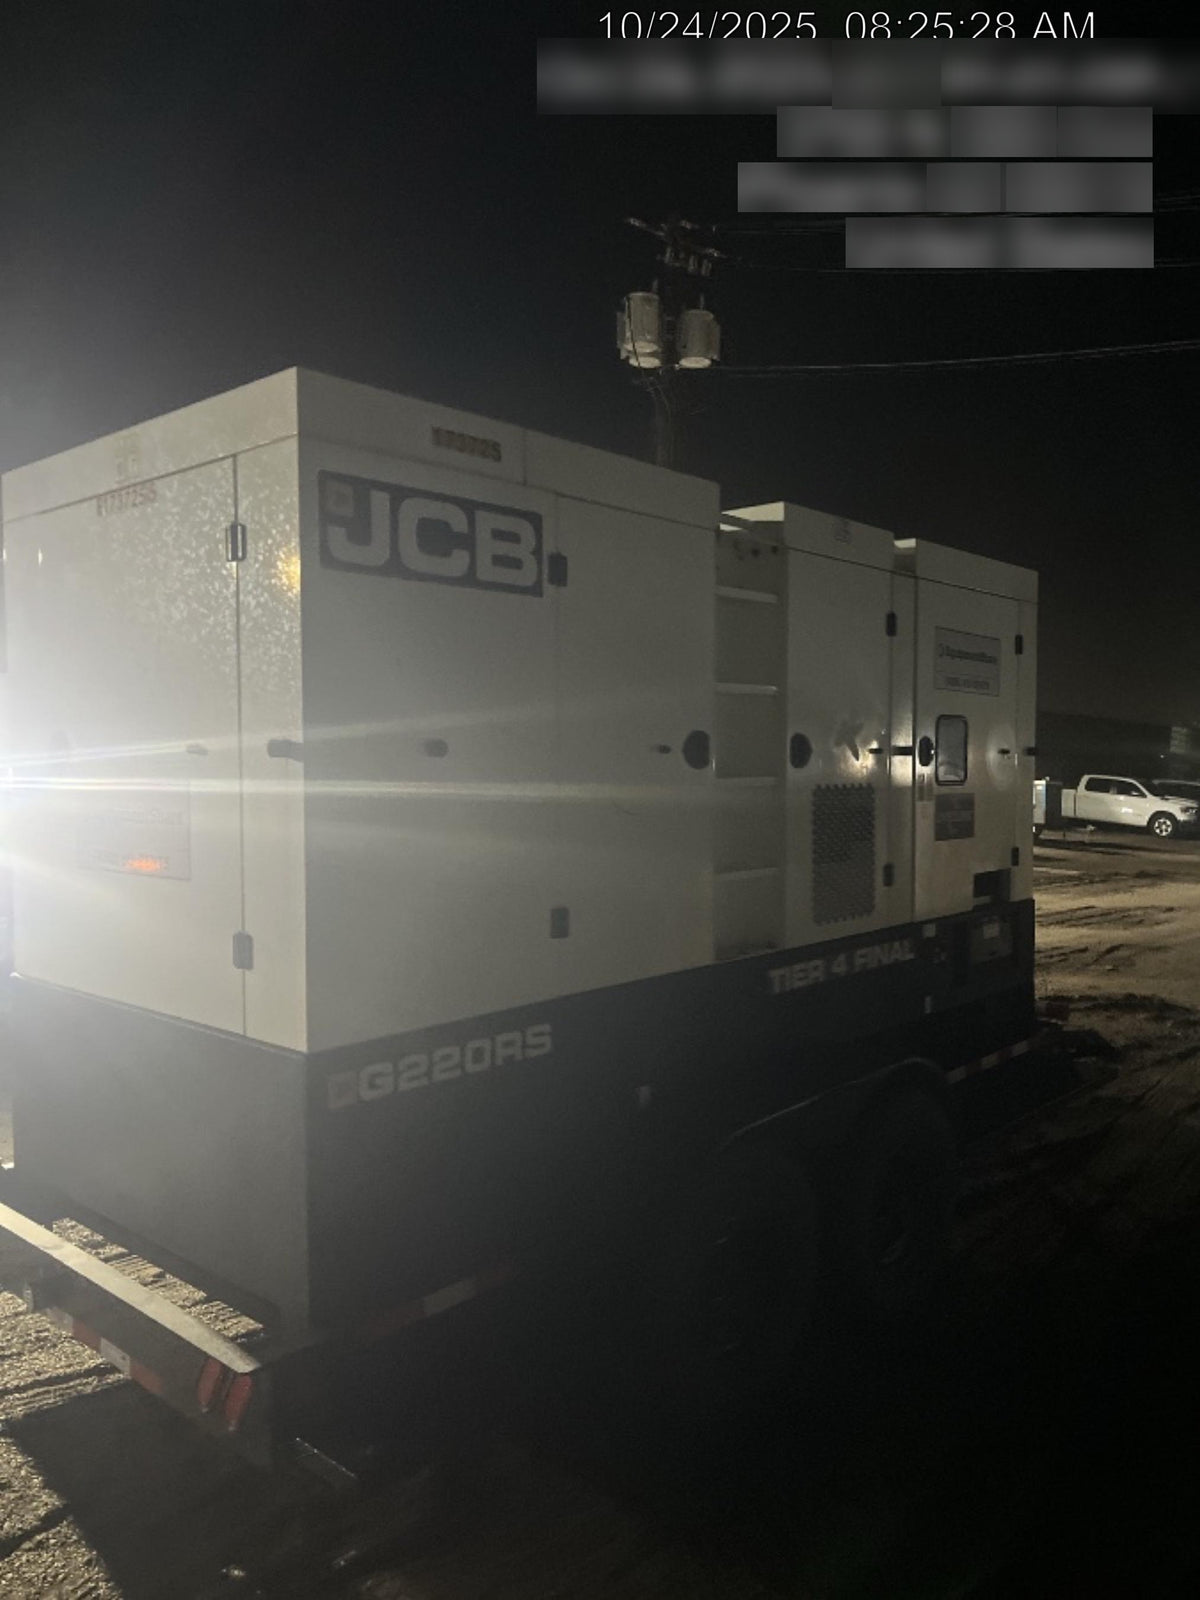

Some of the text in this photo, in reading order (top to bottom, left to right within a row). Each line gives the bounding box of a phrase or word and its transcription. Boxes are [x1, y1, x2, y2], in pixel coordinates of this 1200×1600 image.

[327, 488, 538, 587] JCB
[768, 938, 916, 994] TIER 4 FINAL
